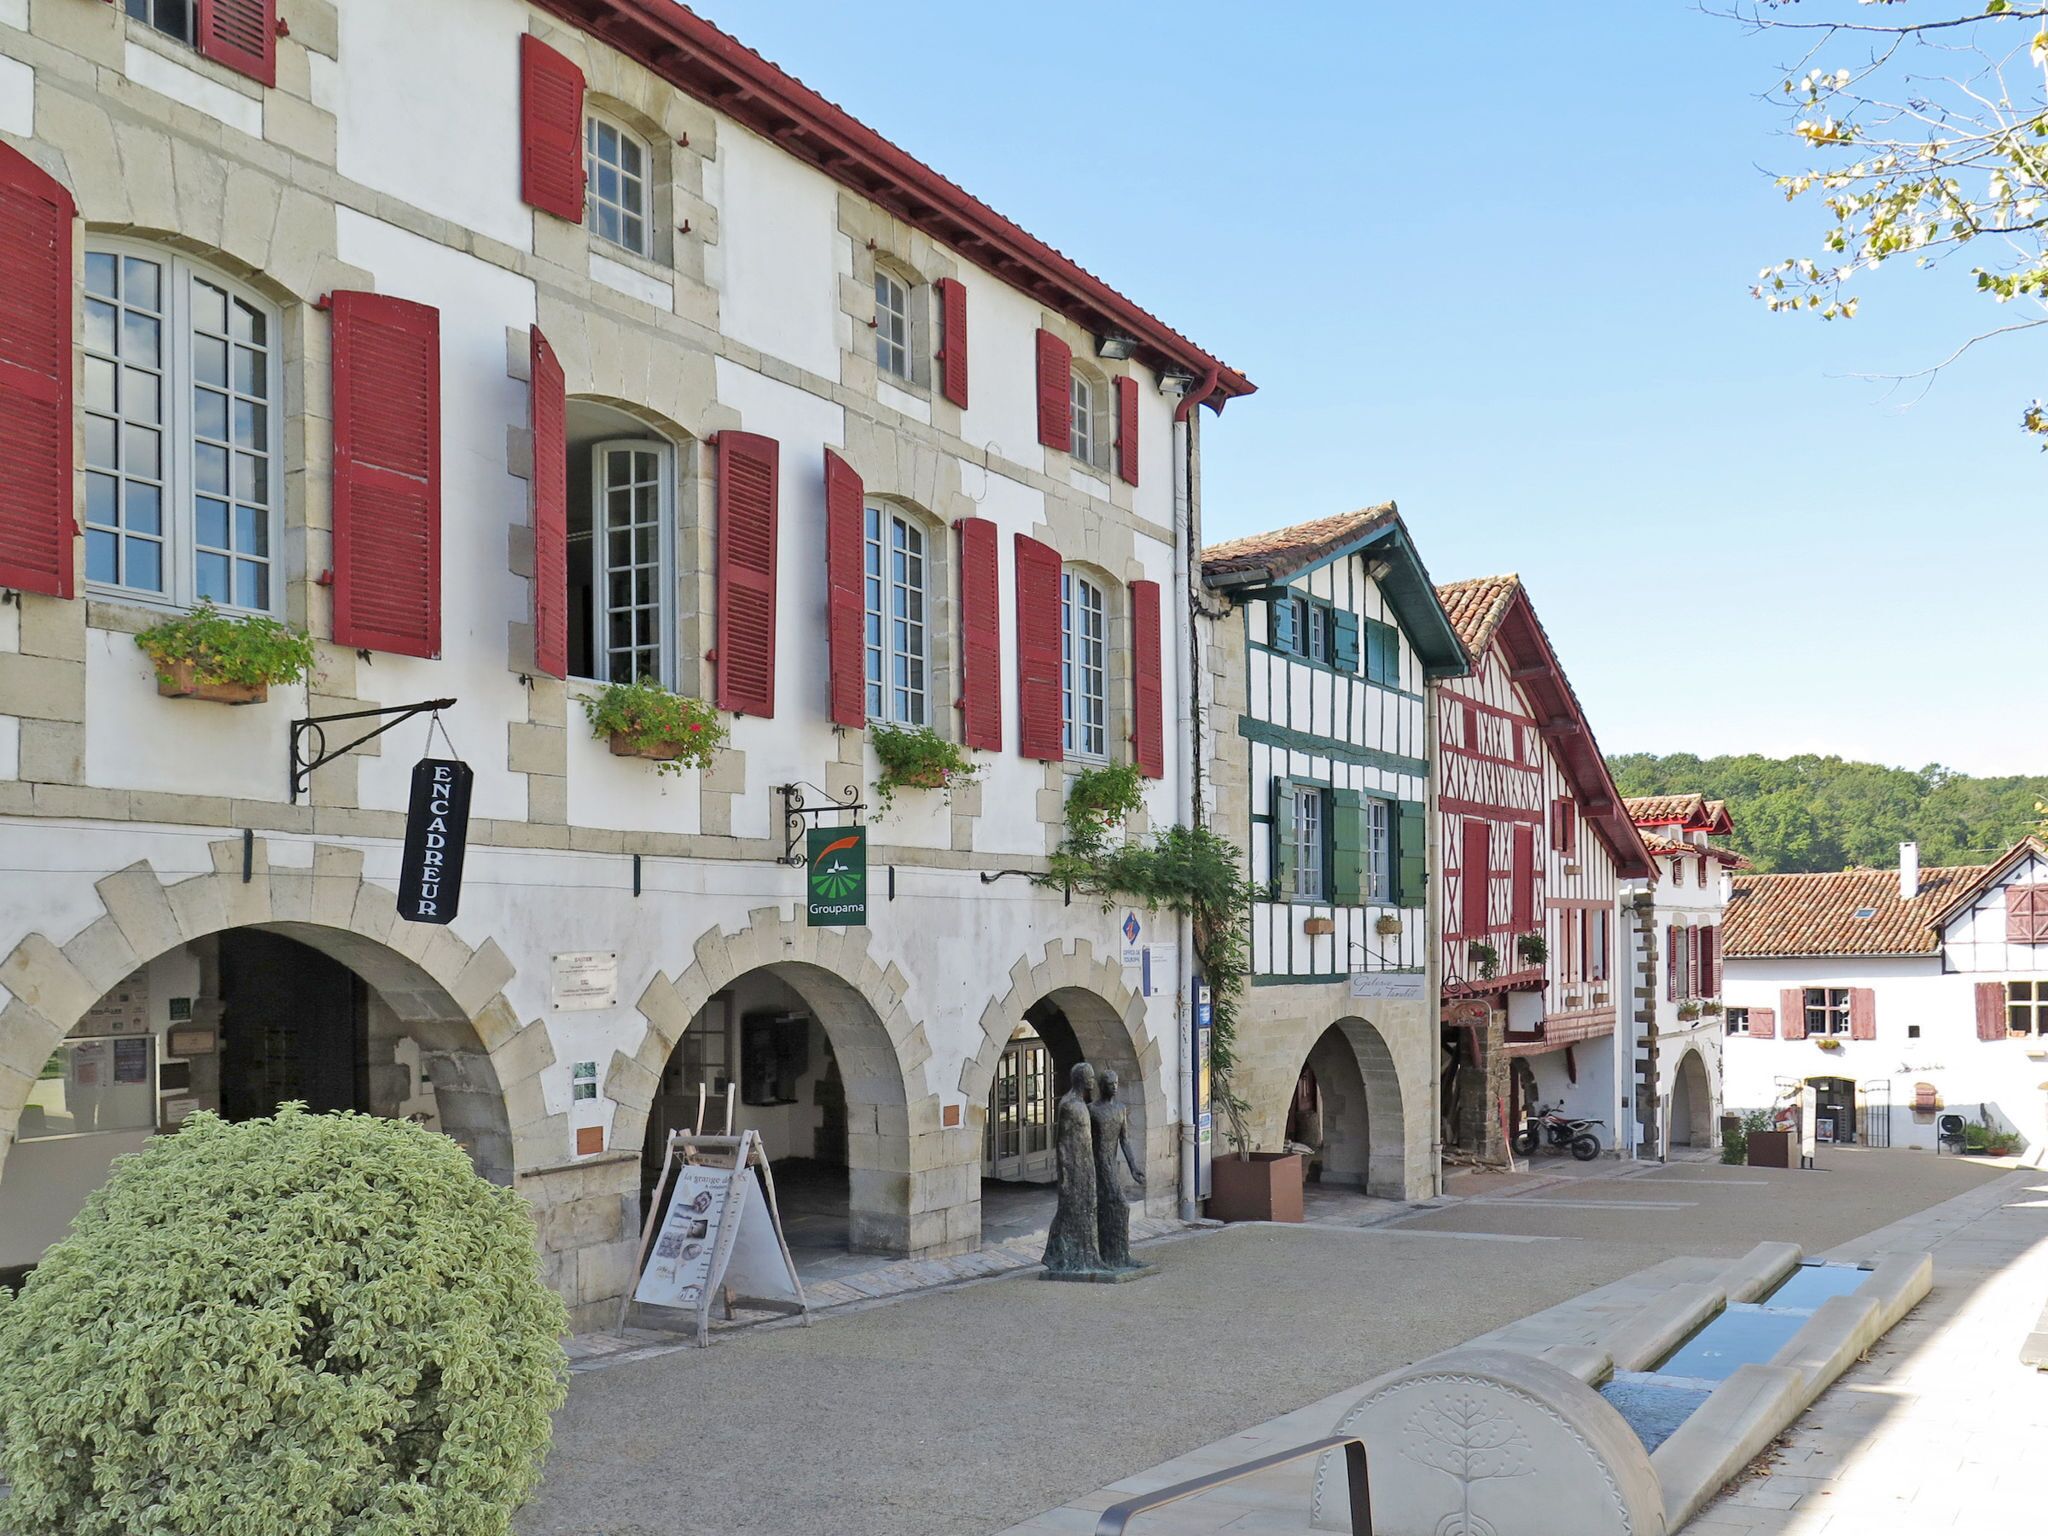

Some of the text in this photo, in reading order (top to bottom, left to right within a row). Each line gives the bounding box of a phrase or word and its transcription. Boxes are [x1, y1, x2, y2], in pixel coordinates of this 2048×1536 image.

[416, 765, 454, 916] ENCADREUR
[809, 903, 865, 915] Groupama
[694, 1175, 721, 1185] grange
